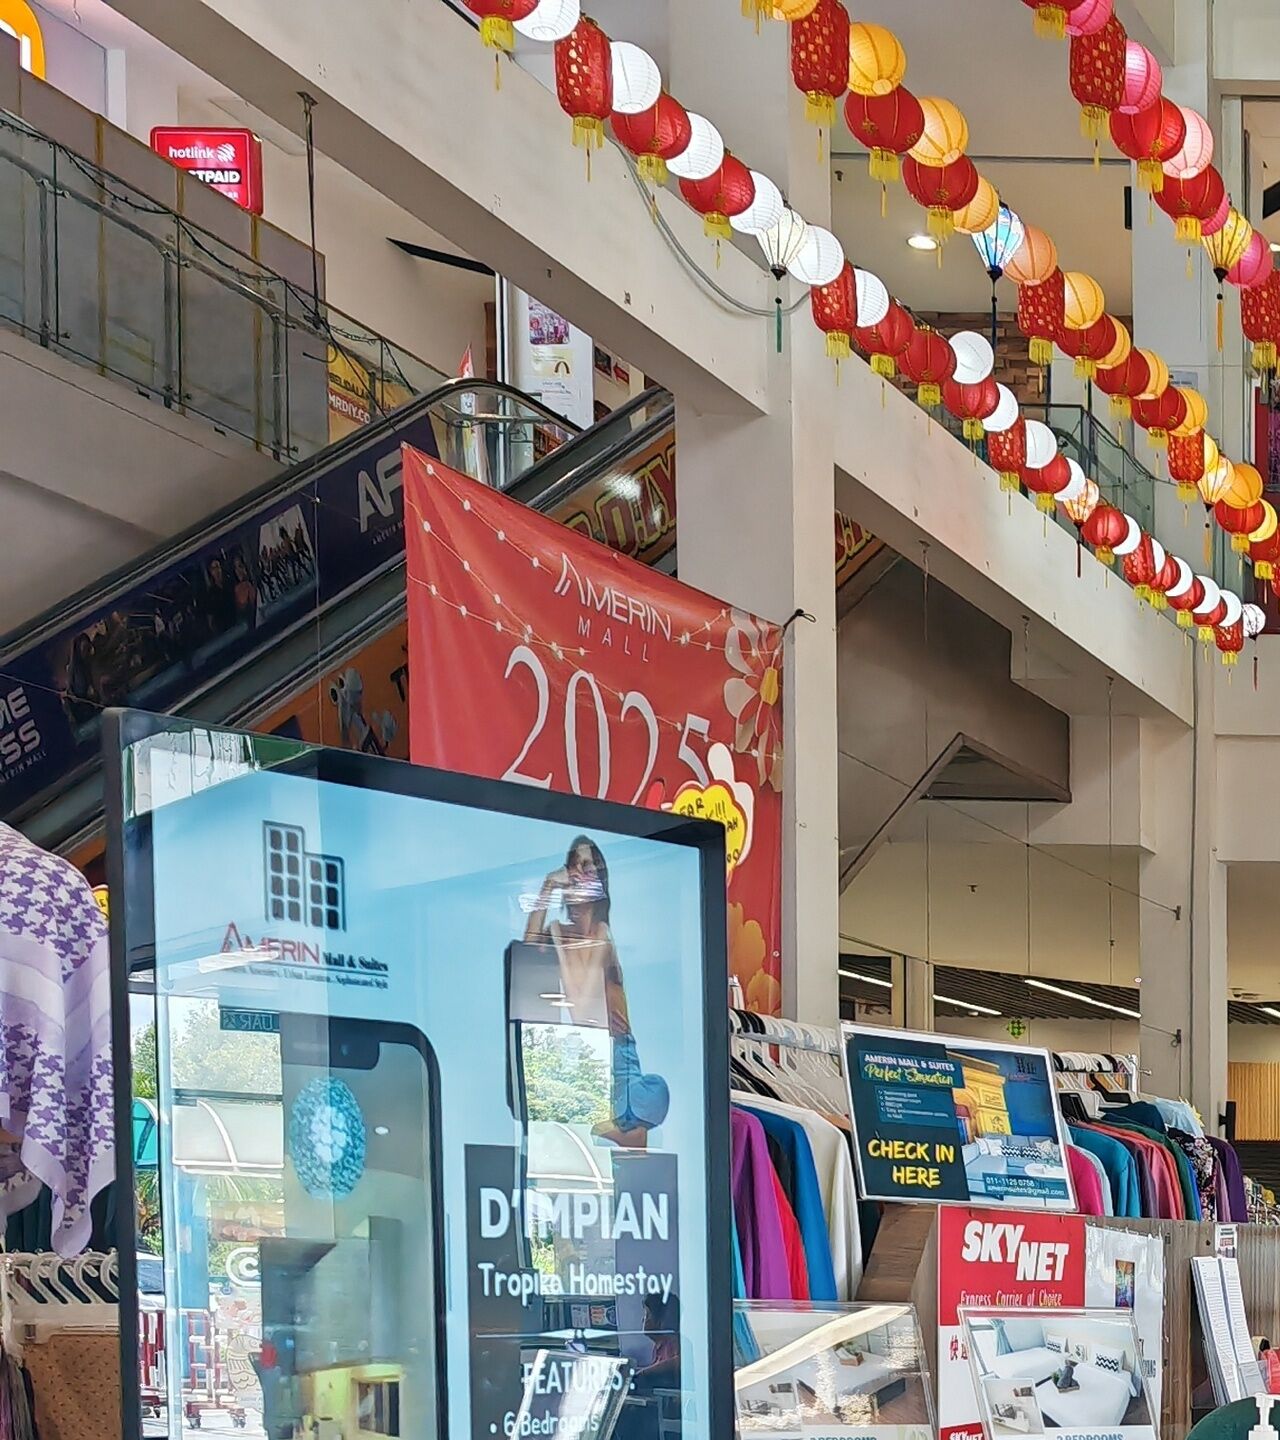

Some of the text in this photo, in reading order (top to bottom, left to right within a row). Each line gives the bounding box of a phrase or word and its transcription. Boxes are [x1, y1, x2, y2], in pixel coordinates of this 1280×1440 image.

[168, 146, 214, 159] hotlink
[188, 170, 241, 183] TPAID
[553, 552, 673, 642] AMERIN
[577, 614, 650, 664] MALL
[500, 644, 711, 808] 2025
[868, 1138, 955, 1164] CHECK IN
[892, 1166, 941, 1189] HERE
[480, 1191, 670, 1242] D'IMPIAN
[961, 1219, 1070, 1281] SKYNET
[478, 1263, 674, 1307] Tropika Homestay
[503, 1411, 515, 1436] 6
